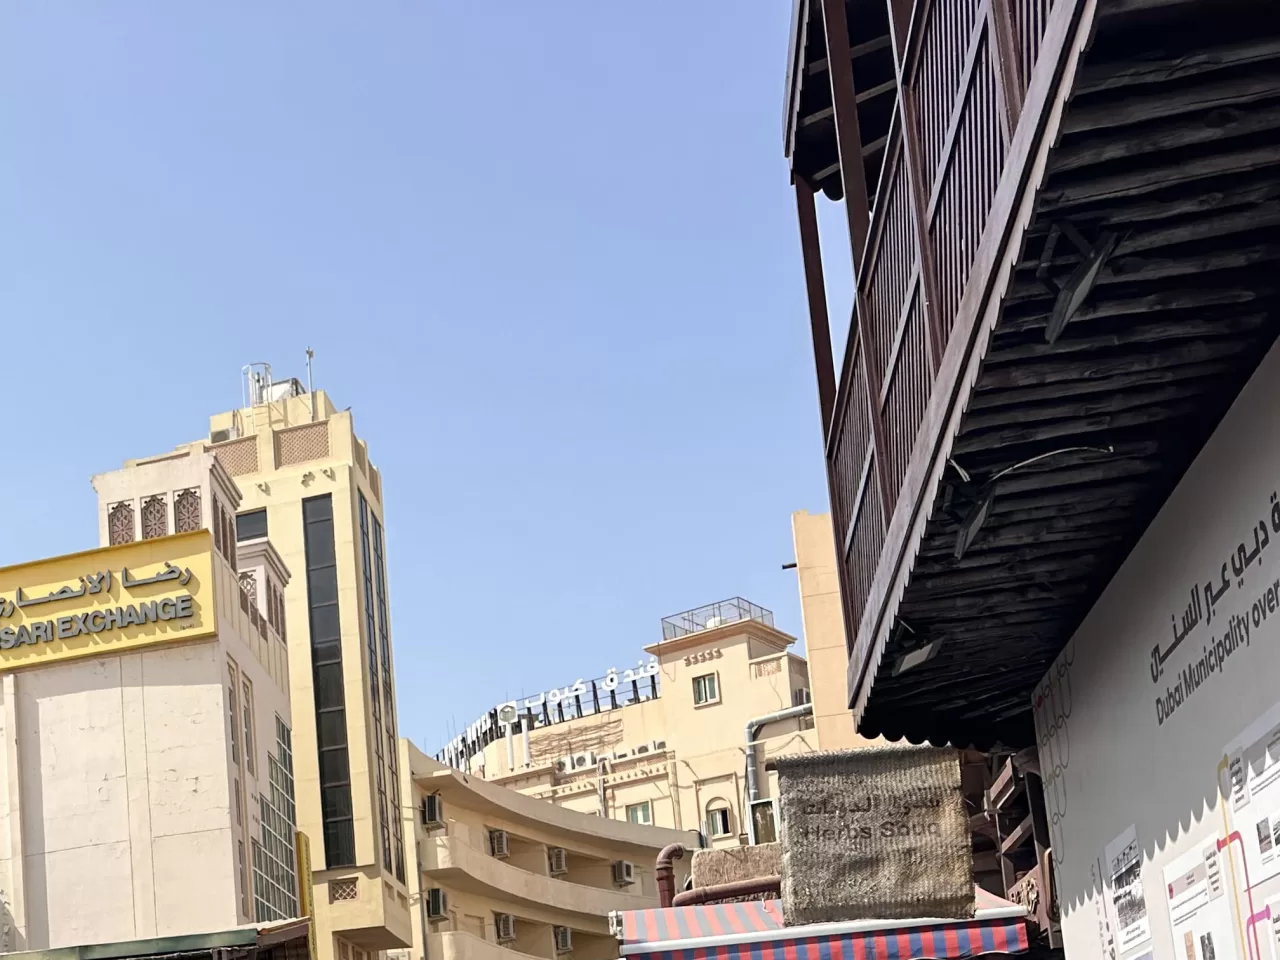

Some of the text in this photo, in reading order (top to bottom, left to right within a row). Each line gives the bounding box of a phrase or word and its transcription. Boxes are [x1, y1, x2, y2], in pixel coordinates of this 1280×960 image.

[122, 561, 192, 589] رضا
[57, 594, 193, 639] EXCHANGE
[1150, 520, 1270, 684] دبي عبر السنين
[601, 656, 660, 691] فندق
[1155, 579, 1280, 726] Dubai Municipality over
